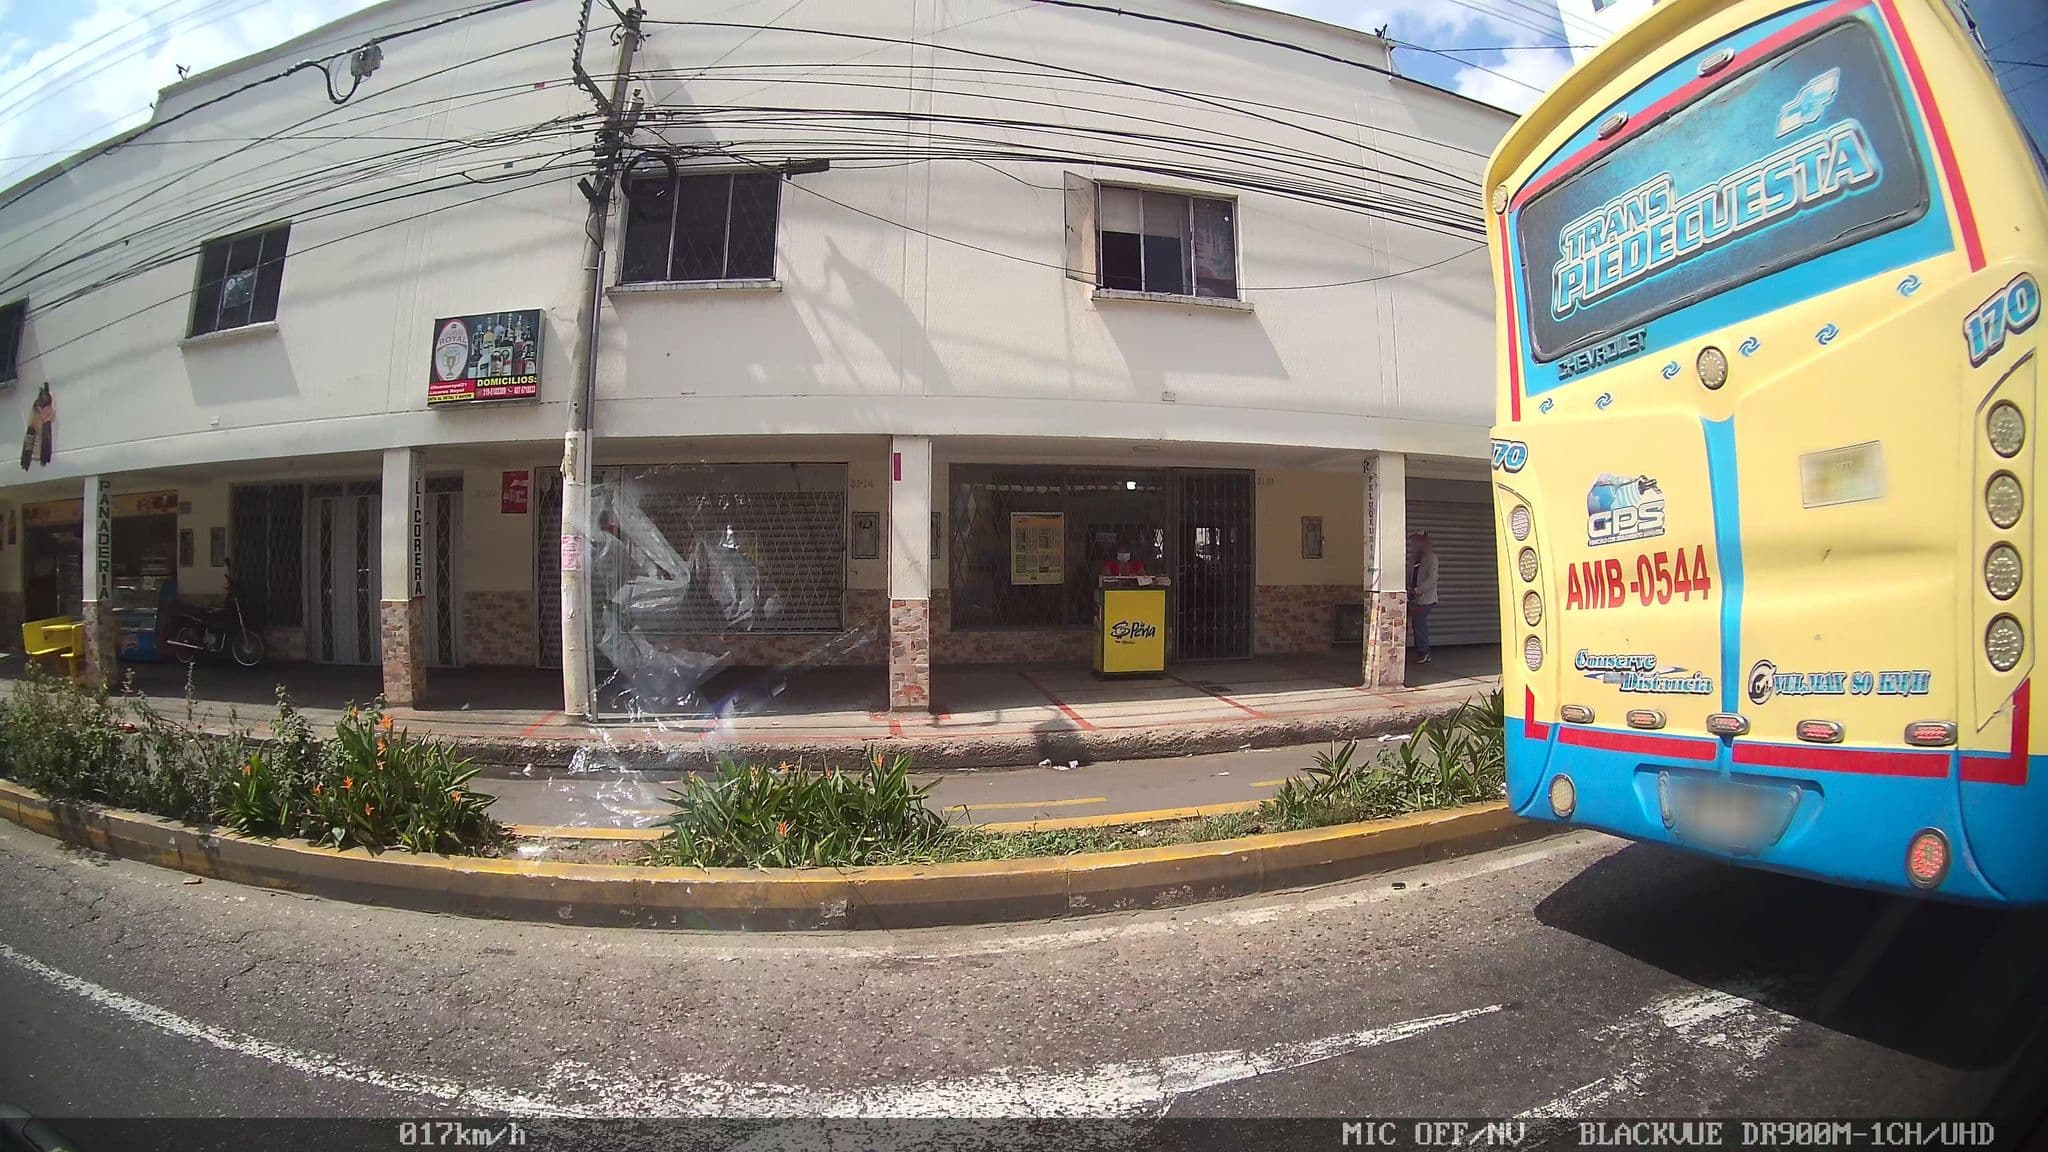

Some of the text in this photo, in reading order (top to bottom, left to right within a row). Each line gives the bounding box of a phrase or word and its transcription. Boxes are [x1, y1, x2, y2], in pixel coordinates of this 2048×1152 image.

[1556, 125, 1875, 312] PIEDECUESTA
[1561, 176, 1675, 259] TRANS
[439, 335, 467, 346] ROYAL
[1963, 272, 2041, 367] 170
[1558, 328, 1647, 381] CHEVROLET
[98, 480, 111, 599] PANADERIA
[414, 481, 422, 595] LICORERA
[1587, 499, 1665, 539] GPS
[1566, 545, 1711, 611] AMB-0544
[1130, 621, 1156, 638] Perla
[1575, 649, 1657, 671] Conserve
[1620, 672, 1713, 694] Distancia
